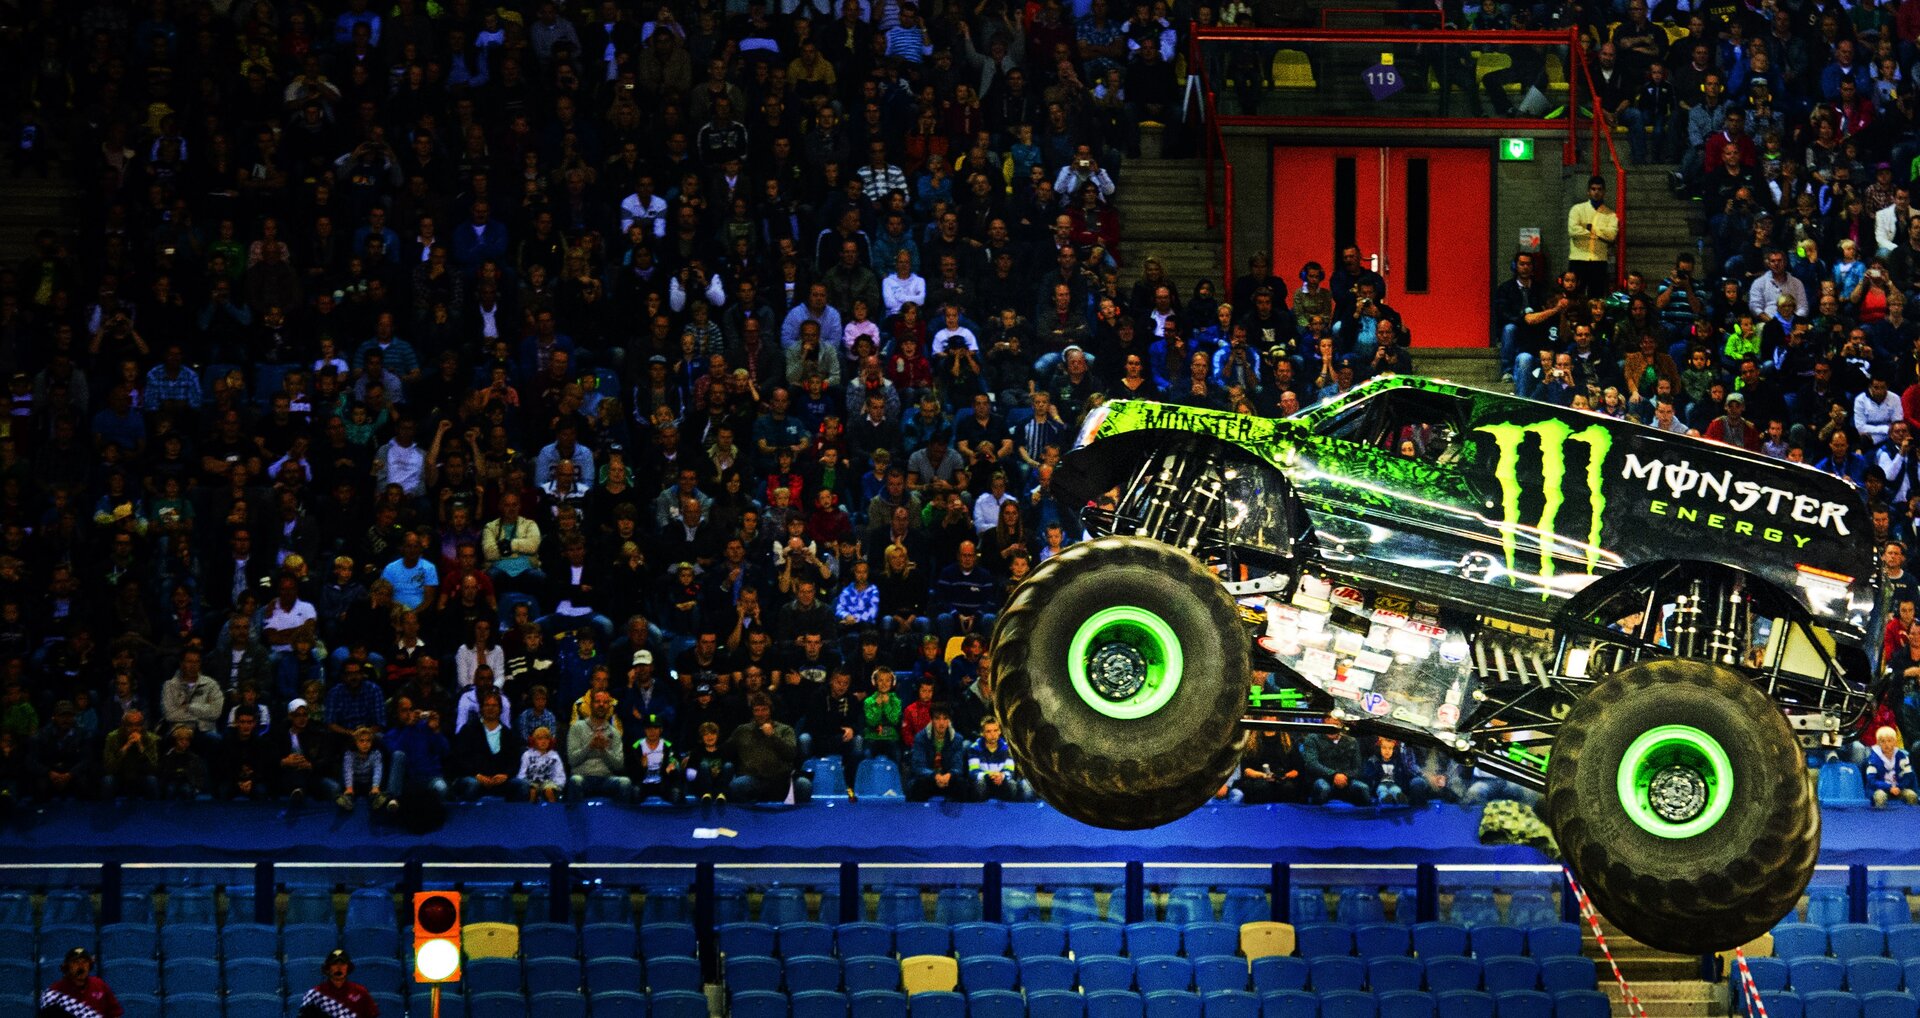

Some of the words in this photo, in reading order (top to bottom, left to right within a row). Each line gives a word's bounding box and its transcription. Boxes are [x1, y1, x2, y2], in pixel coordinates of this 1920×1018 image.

[1367, 72, 1396, 85] 119
[1145, 409, 1253, 442] MONSTER
[1621, 453, 1851, 536] MONSTER
[1649, 501, 1811, 549] ENERGY
[1407, 620, 1445, 636] ARP
